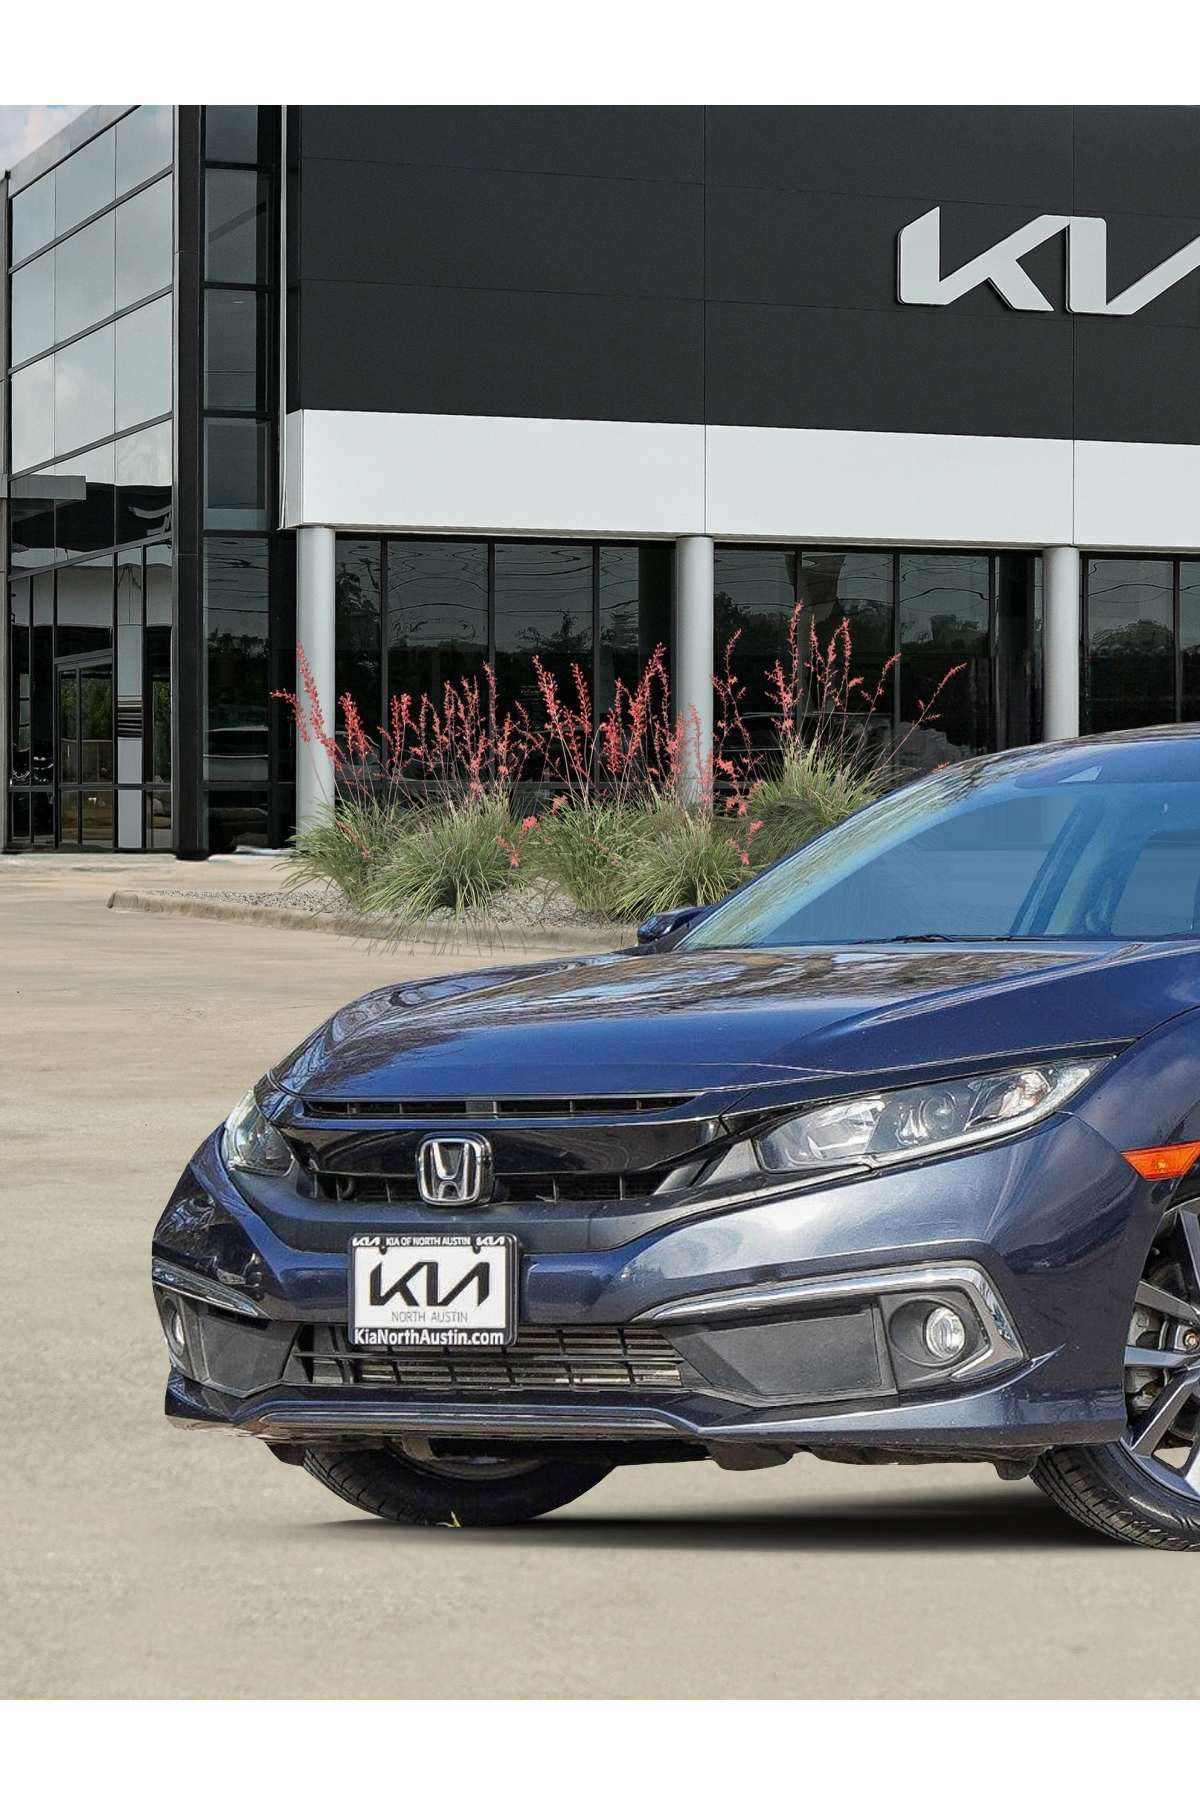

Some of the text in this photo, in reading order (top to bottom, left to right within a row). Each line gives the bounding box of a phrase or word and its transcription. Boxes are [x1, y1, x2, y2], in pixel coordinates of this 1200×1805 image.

[386, 1236, 471, 1246] KIA OF NORTH AUSTIN
[369, 1261, 490, 1307] KIA
[391, 1311, 468, 1323] NORTH AUSTIN
[354, 1328, 504, 1345] KiaNorthAustin.com
